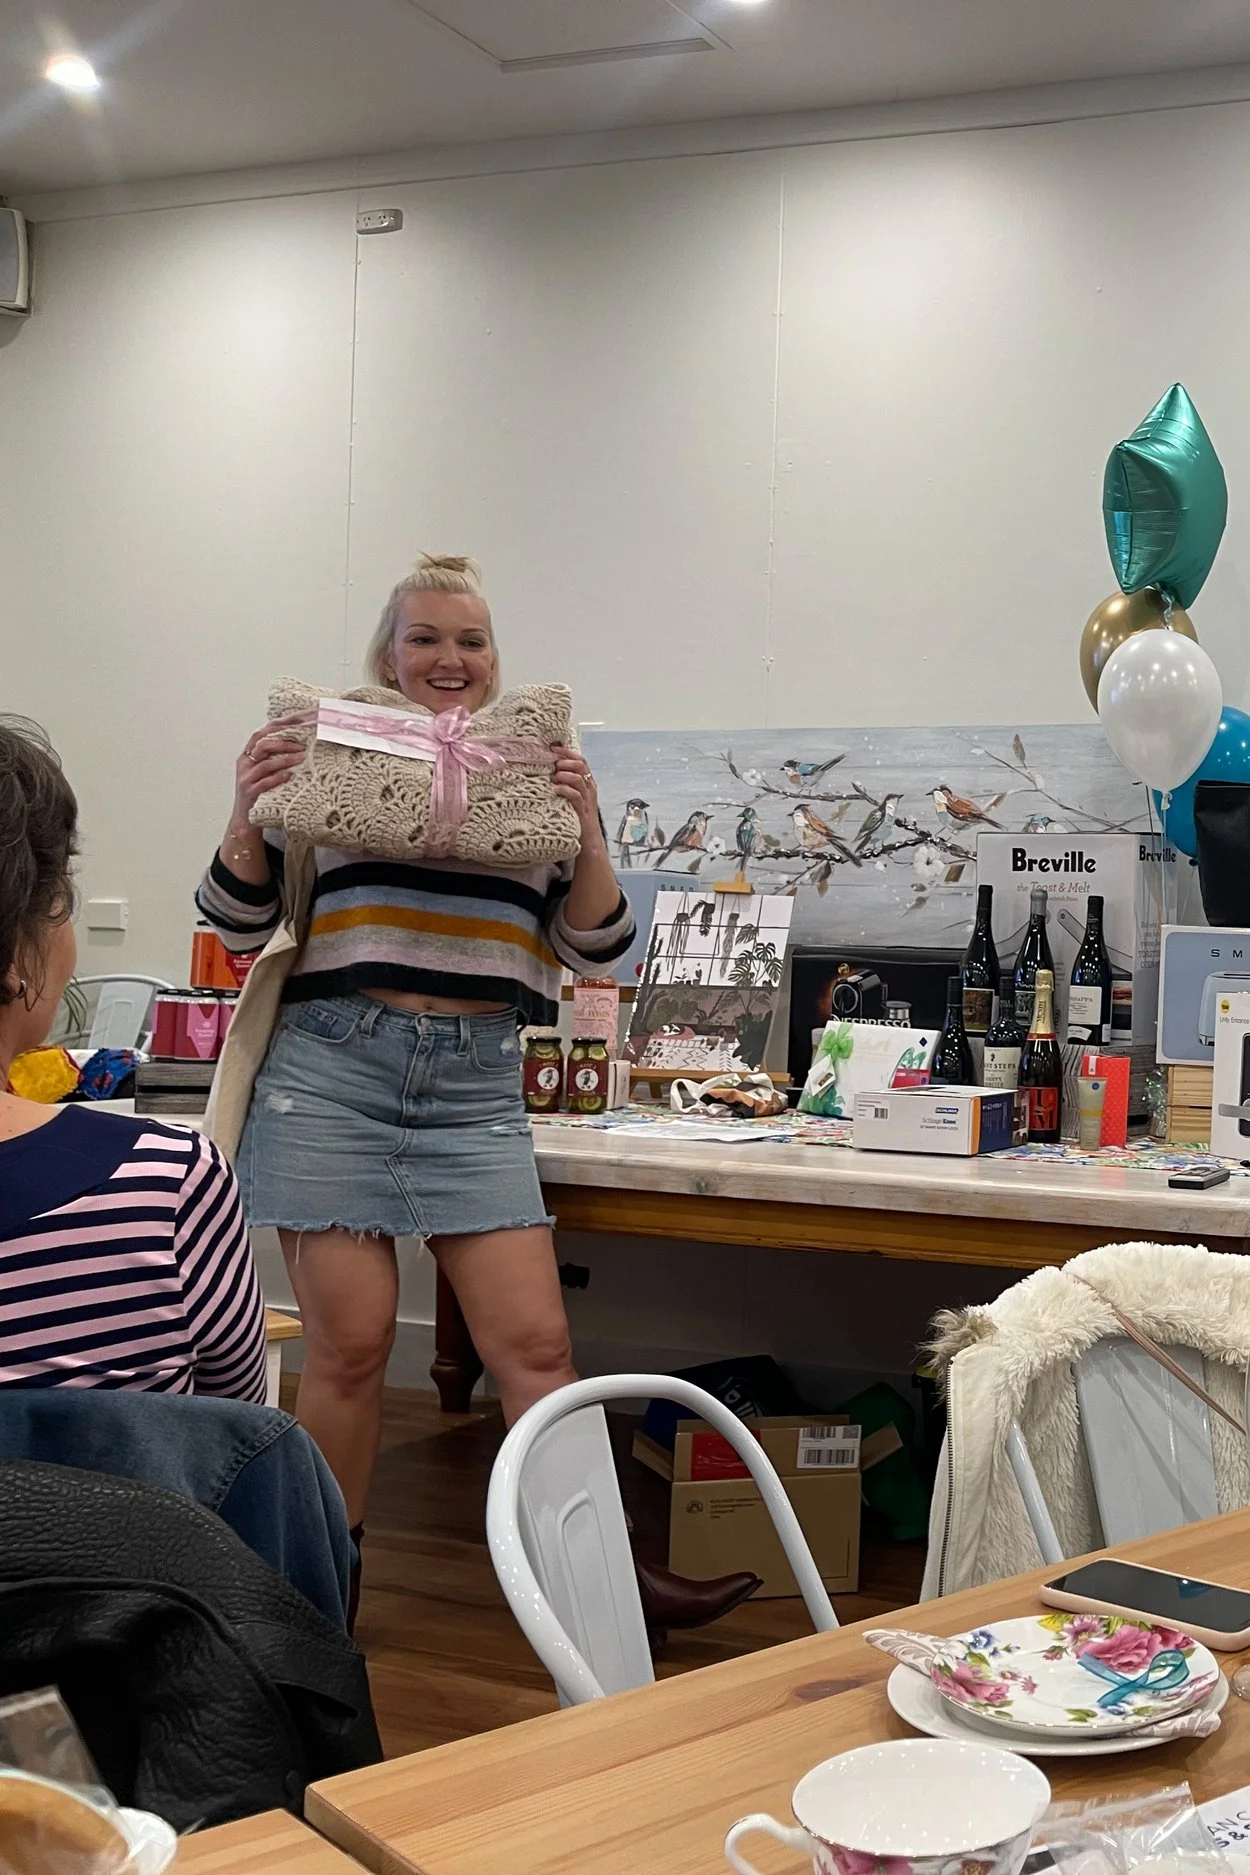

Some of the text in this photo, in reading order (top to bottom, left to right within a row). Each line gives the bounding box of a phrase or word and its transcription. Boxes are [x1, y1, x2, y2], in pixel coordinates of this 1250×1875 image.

[1012, 848, 1097, 873] Breville
[1139, 845, 1177, 863] Breville
[1017, 882, 1029, 892] the
[1058, 882, 1066, 893] &
[1067, 881, 1091, 893] Melt
[1228, 1831, 1248, 1841] &
